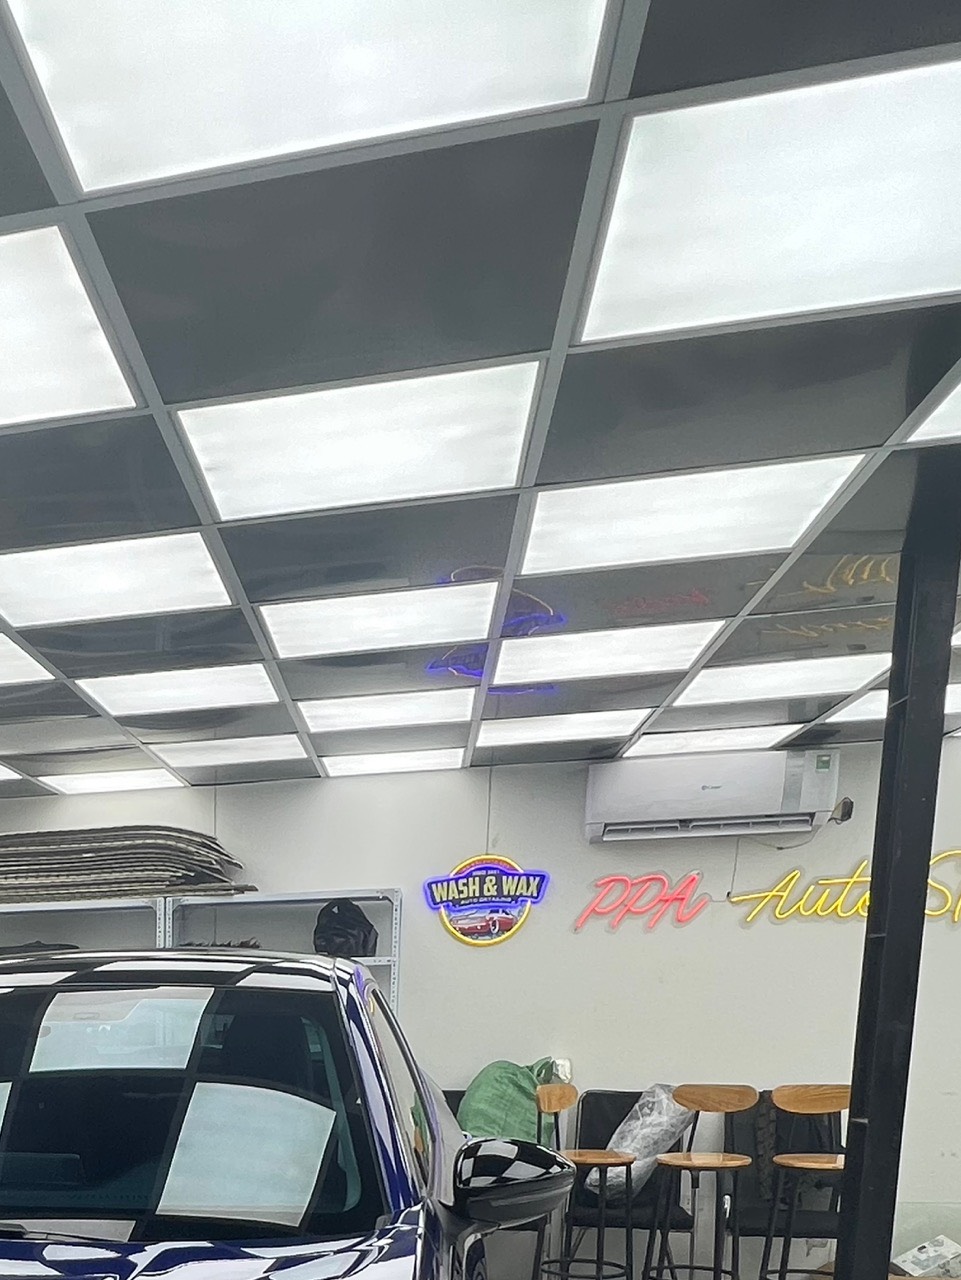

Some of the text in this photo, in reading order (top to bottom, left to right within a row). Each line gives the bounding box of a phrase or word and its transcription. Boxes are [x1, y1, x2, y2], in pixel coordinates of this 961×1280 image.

[431, 874, 541, 903] WASH & WAX
[574, 873, 710, 930] PPA
[924, 850, 961, 922] S
